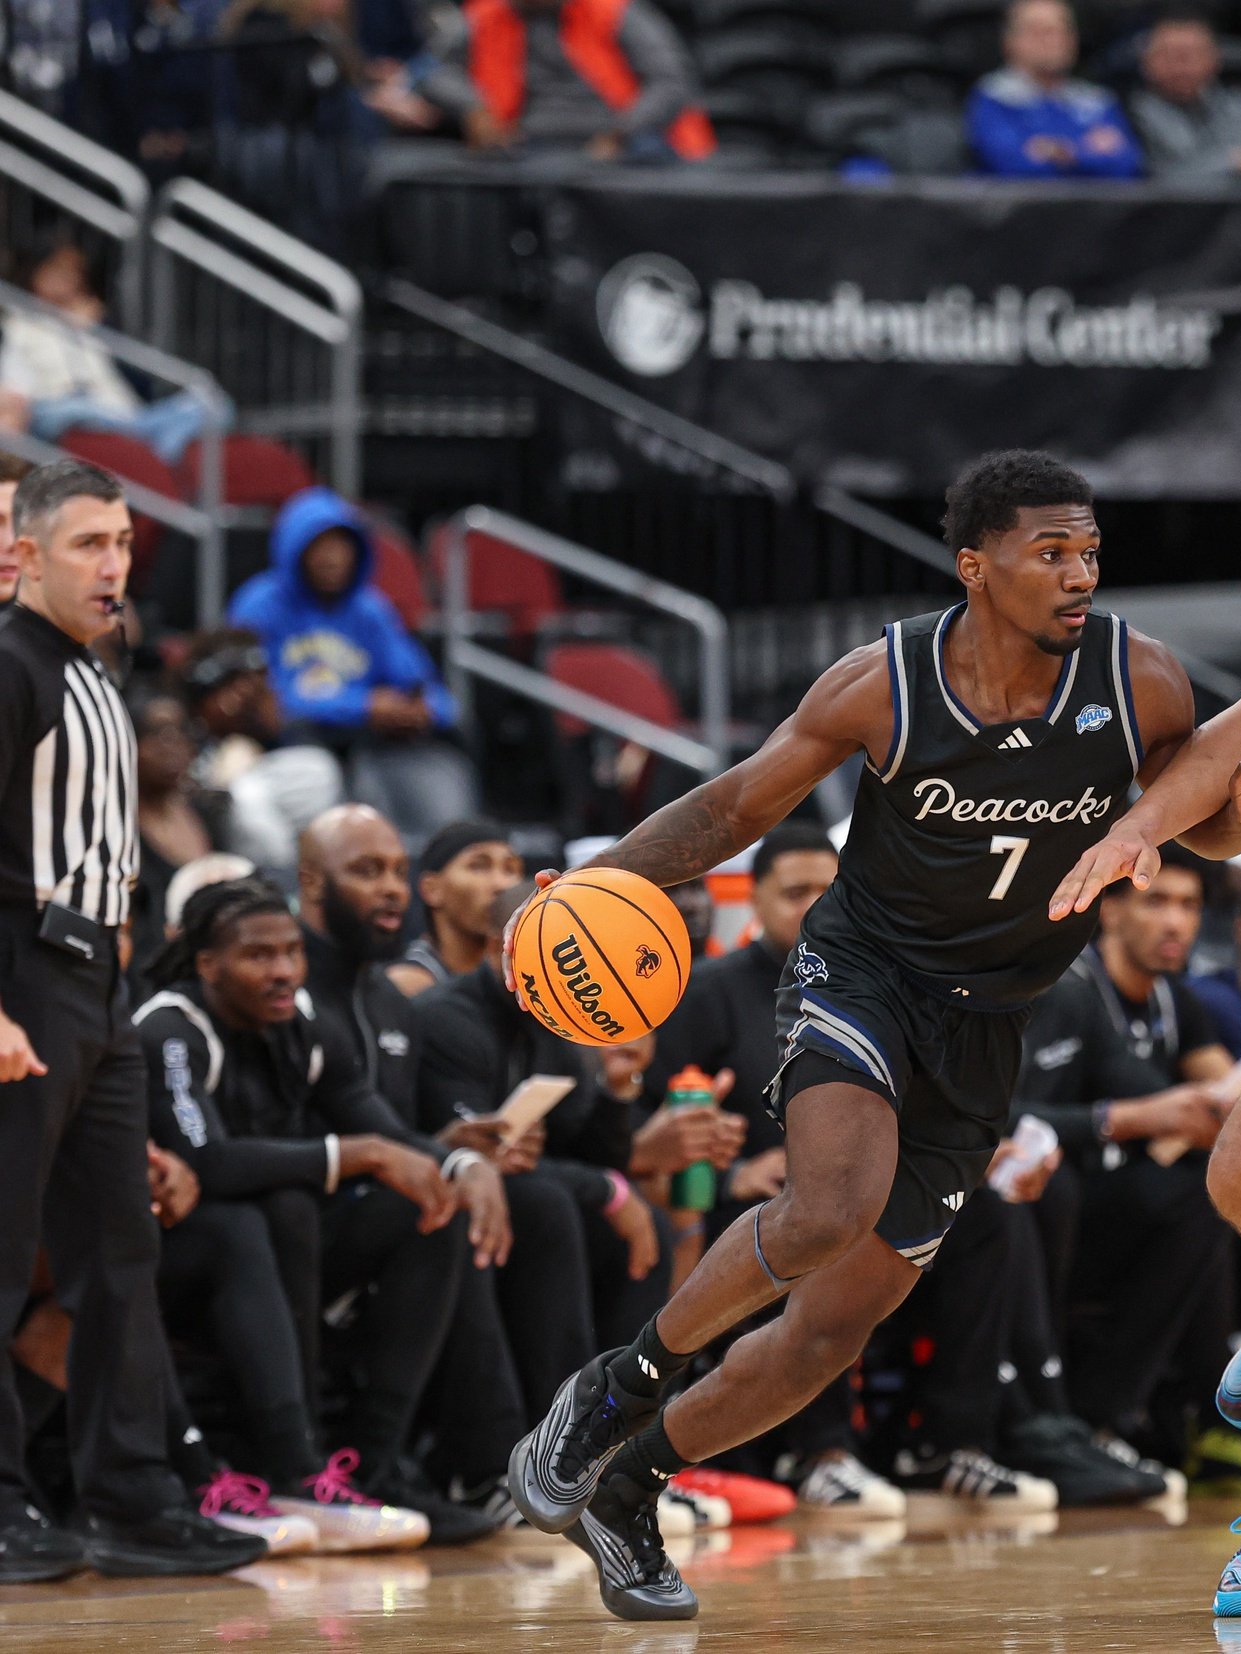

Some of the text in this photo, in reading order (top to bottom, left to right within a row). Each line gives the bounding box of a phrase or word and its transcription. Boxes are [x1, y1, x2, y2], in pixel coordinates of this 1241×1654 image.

[710, 279, 1221, 369] Prudential Center
[1077, 709, 1109, 730] MAAC
[913, 778, 1112, 825] Peacocks
[988, 835, 1030, 900] 7
[552, 933, 625, 1037] Wilson
